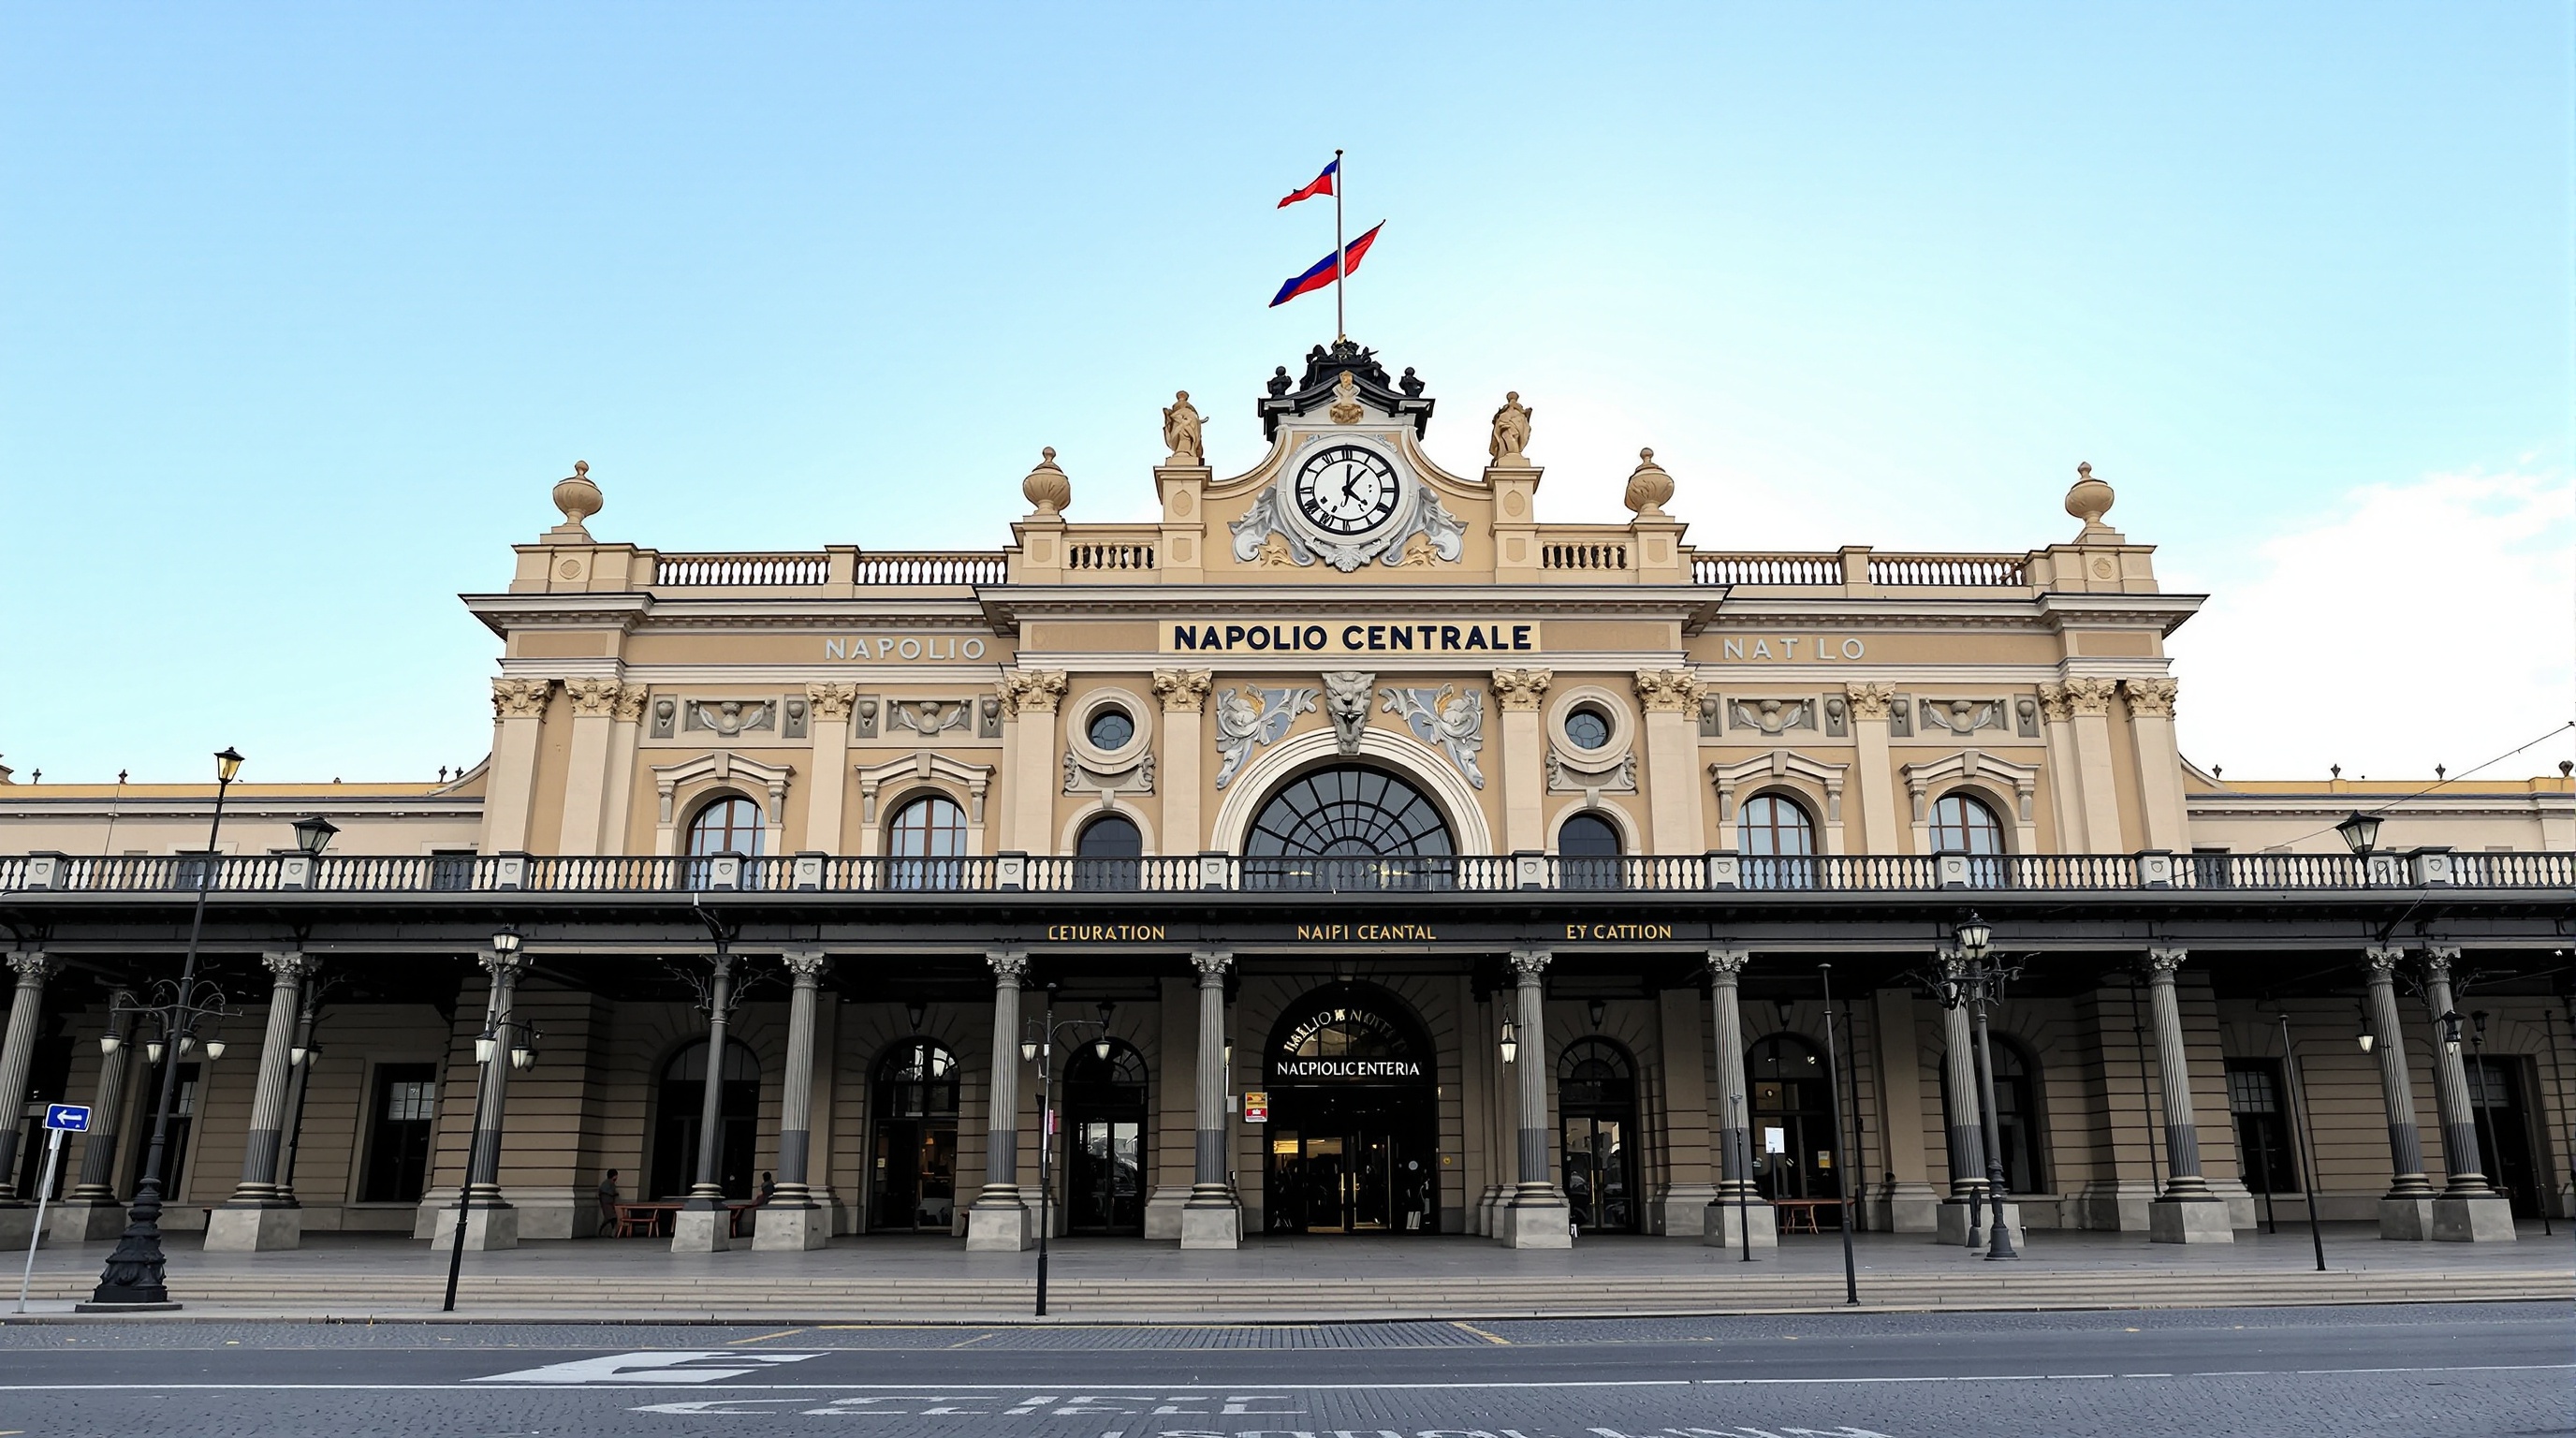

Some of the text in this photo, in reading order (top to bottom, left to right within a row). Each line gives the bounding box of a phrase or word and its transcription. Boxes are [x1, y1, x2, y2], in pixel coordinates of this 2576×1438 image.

[1174, 624, 1531, 651] NAPOLIO CENTRALE
[825, 638, 986, 659] NAPOLIO
[1357, 924, 1437, 940] CEANTAL
[1593, 924, 1671, 940] CATTION
